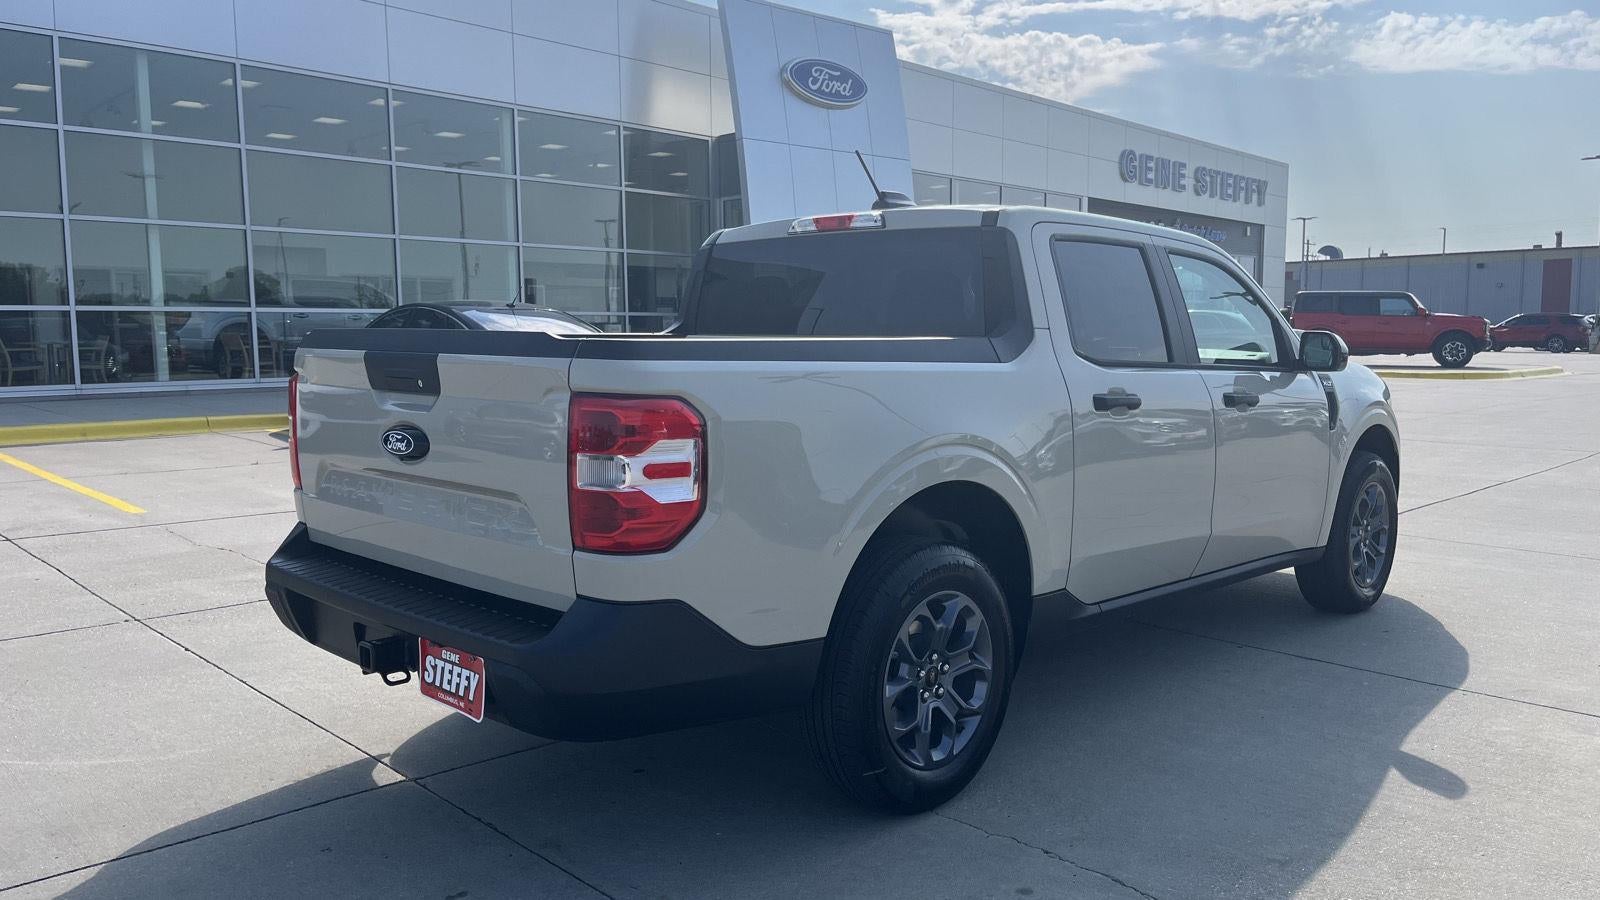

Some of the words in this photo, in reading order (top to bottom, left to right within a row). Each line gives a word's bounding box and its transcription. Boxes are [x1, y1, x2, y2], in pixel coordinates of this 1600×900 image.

[808, 66, 853, 96] Ford
[1119, 149, 1187, 192] GENE
[1193, 166, 1268, 207] STEFFY
[387, 433, 407, 451] Ford
[441, 649, 460, 663] GENE
[424, 655, 480, 701] STEFFY
